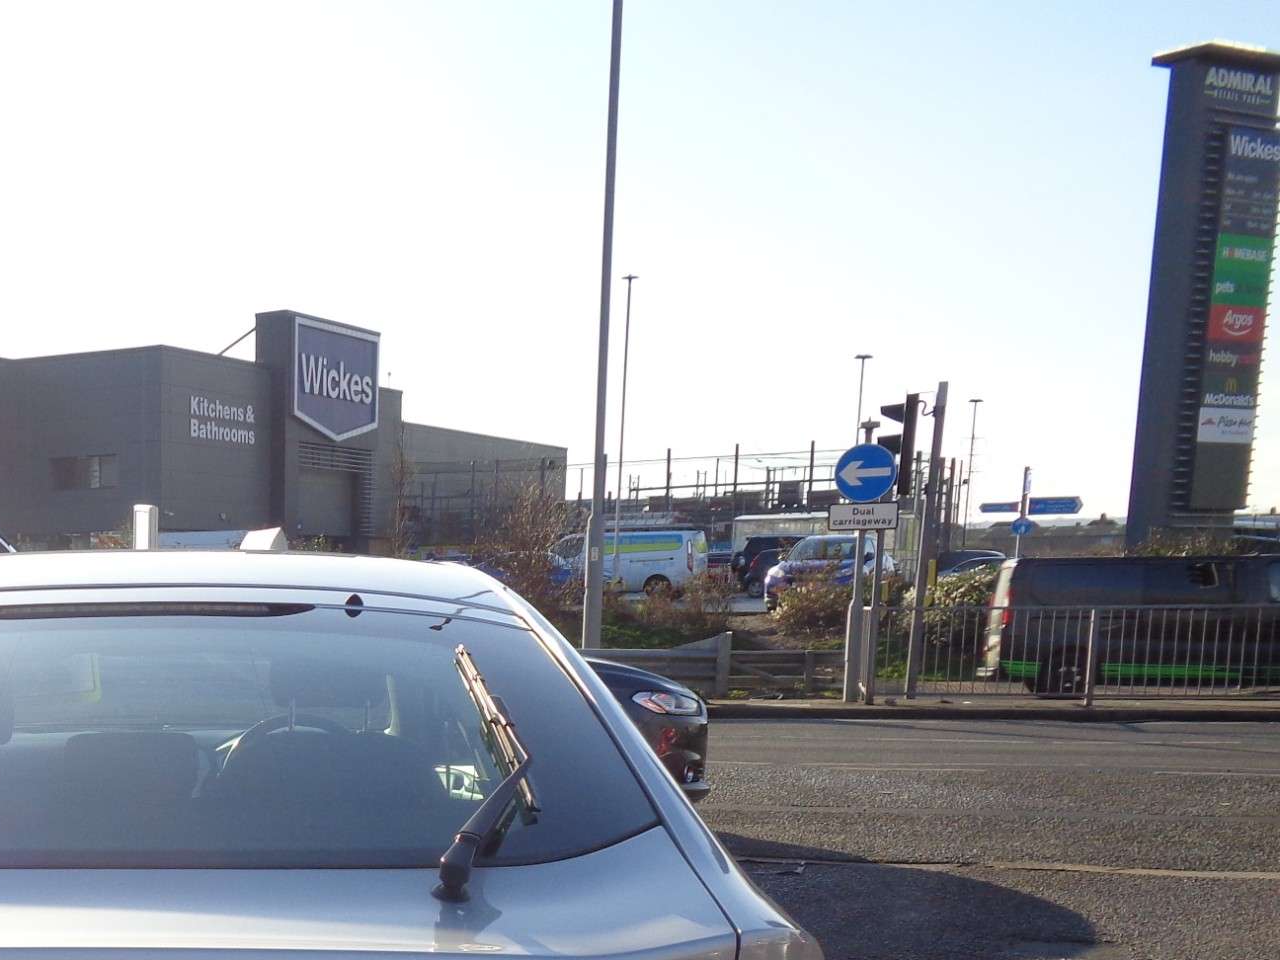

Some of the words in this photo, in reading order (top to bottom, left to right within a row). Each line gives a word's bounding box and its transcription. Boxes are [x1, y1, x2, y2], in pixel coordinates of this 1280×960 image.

[1205, 66, 1273, 96] ADMIRAL
[1231, 134, 1280, 161] Wickes
[1224, 310, 1254, 329] Argos
[1209, 350, 1239, 367] hobby
[301, 353, 373, 404] Wickes
[190, 396, 244, 421] Kitchens
[246, 405, 255, 423] &
[190, 418, 256, 445] Bathrooms
[832, 518, 893, 527] carriageway
[852, 507, 874, 516] Dual
